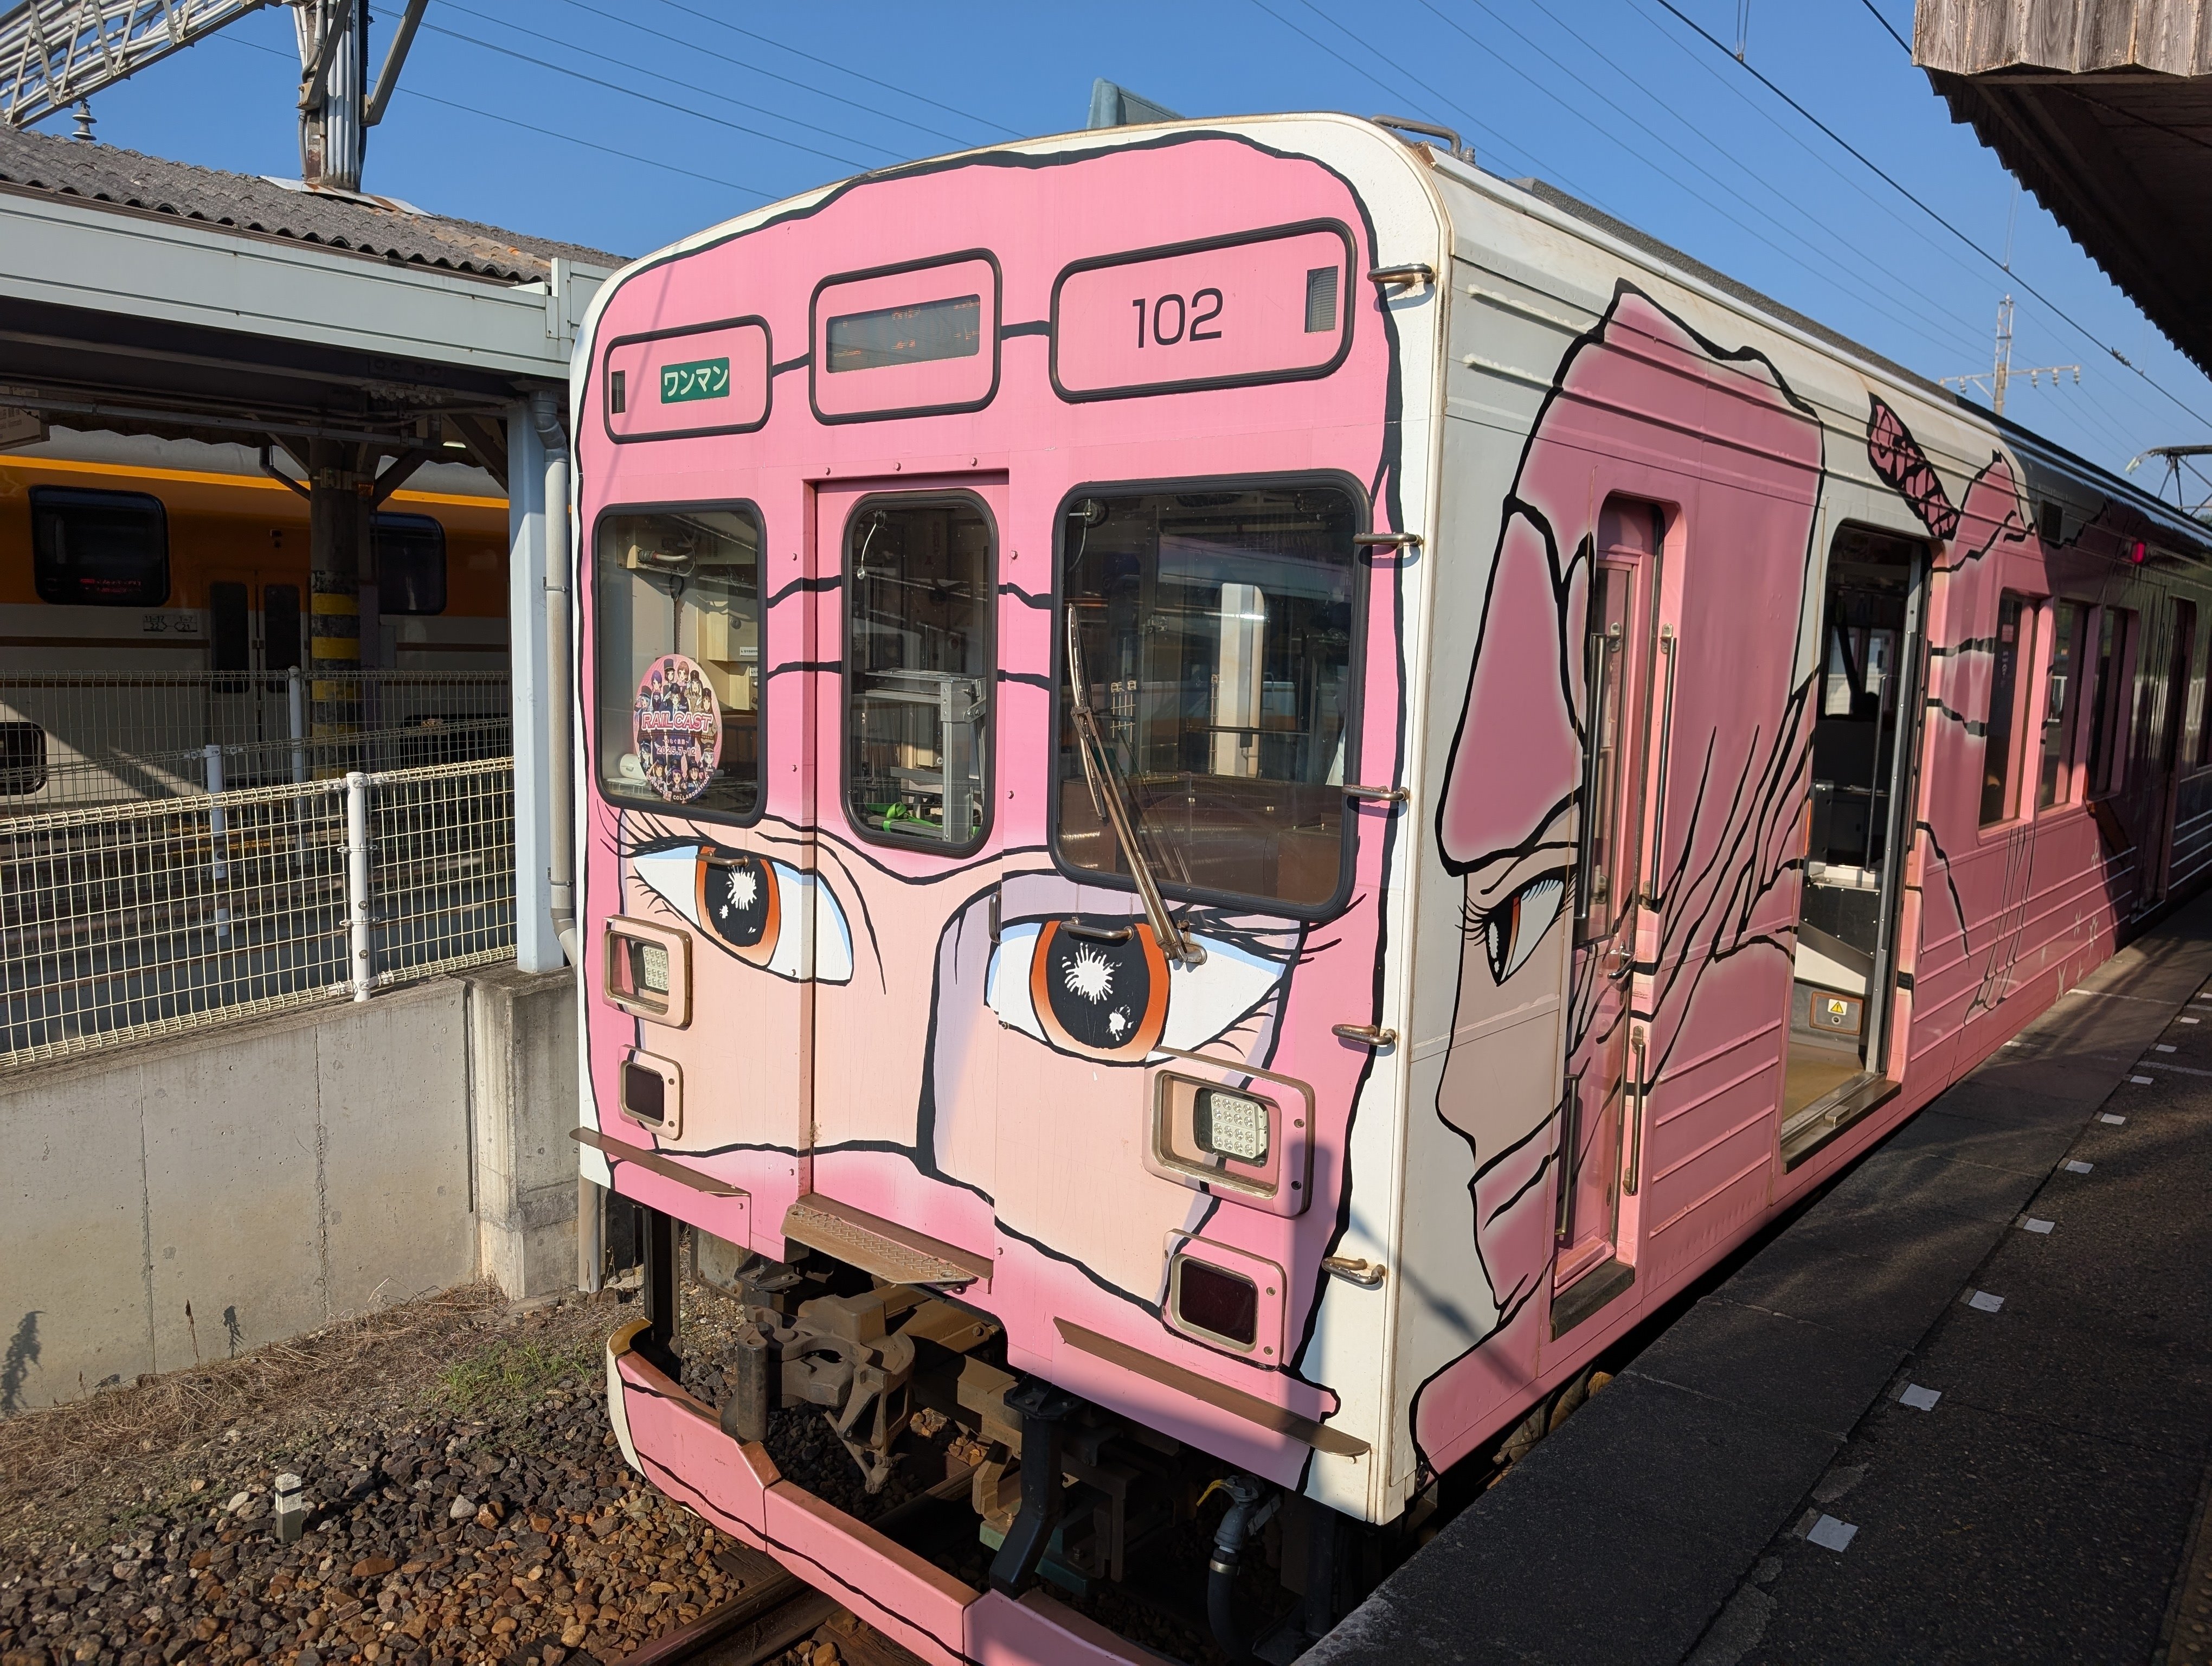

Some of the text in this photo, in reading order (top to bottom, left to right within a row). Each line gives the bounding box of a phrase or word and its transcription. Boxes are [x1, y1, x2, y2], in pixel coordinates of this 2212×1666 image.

[1133, 287, 1223, 348] 102
[664, 366, 728, 396] ワンマン
[673, 774, 711, 801] COLLABORATION
